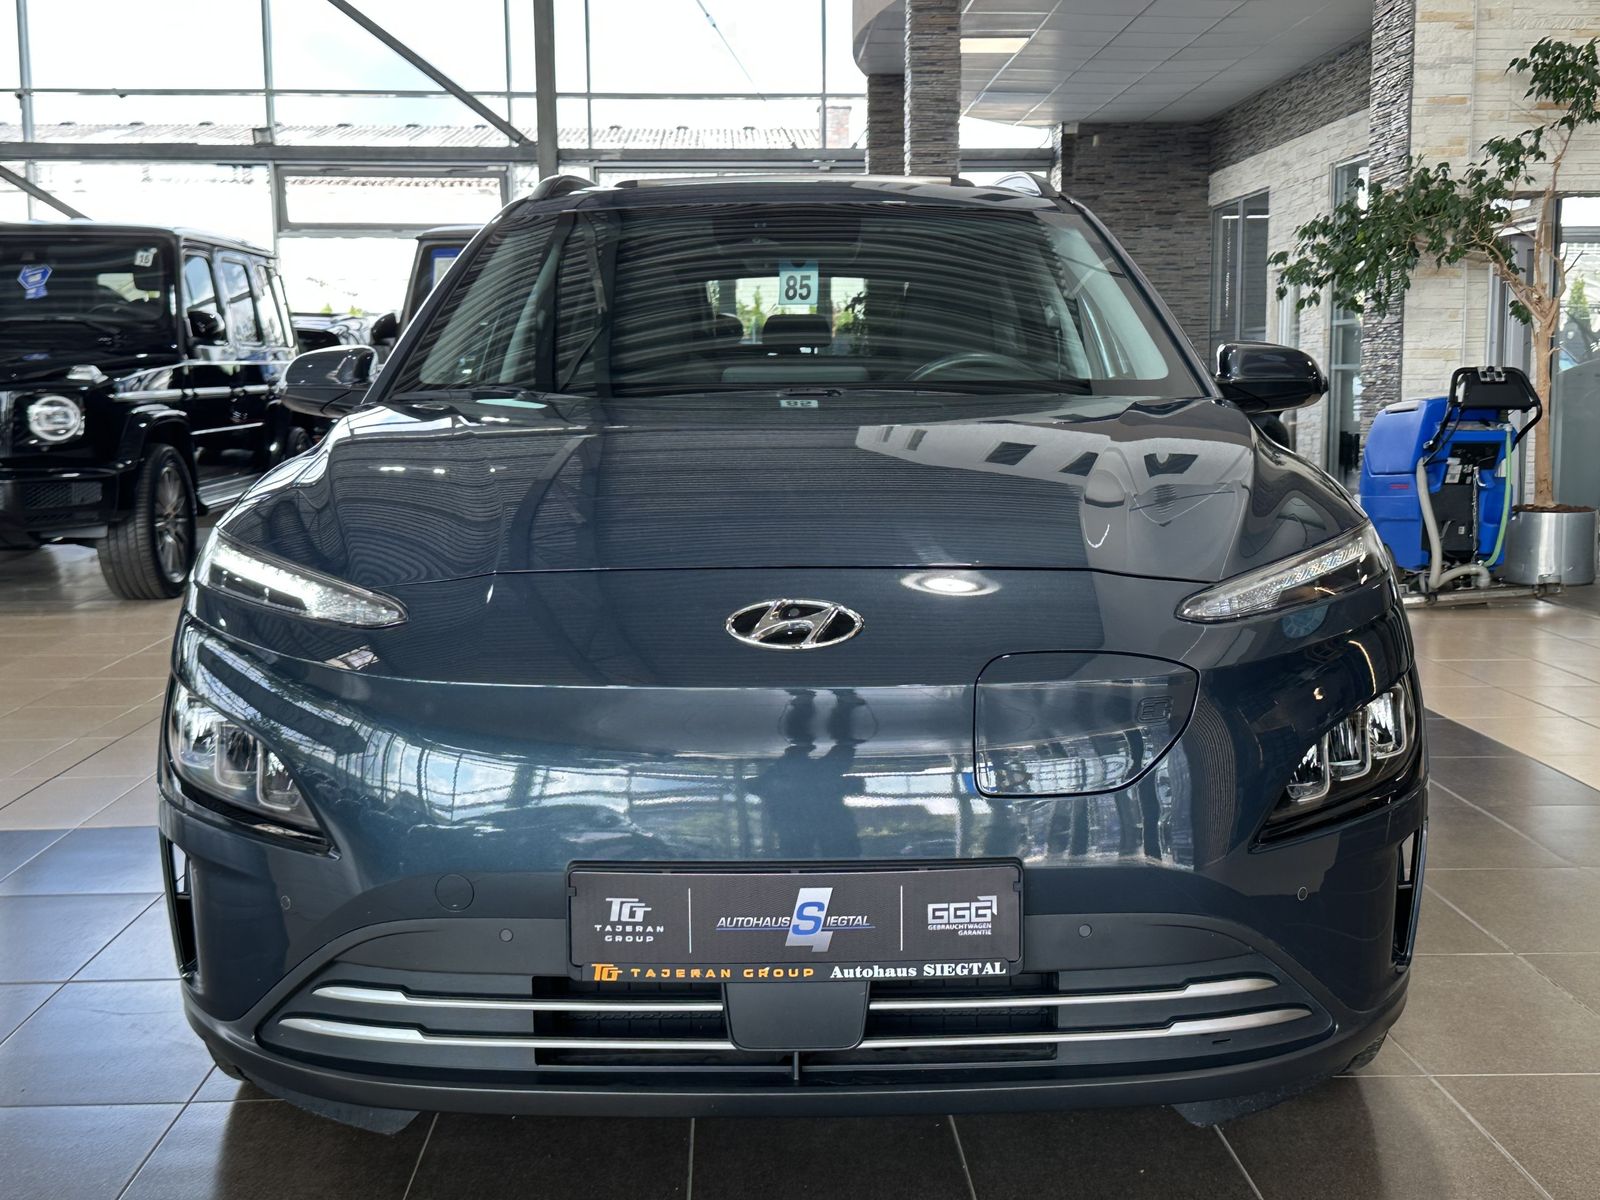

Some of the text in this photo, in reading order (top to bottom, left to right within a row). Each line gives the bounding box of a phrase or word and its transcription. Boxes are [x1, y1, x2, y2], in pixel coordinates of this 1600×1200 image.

[784, 275, 812, 301] 85
[927, 901, 992, 924] GGG
[594, 924, 664, 933] TAJERAN
[716, 916, 792, 928] AUTOHAUS
[927, 922, 992, 931] GEBRAUCHTWAGEN
[630, 968, 731, 978] TAJERAN
[743, 967, 814, 978] GROUP
[830, 965, 917, 979] Autohaus
[923, 961, 1007, 976] SIEGTAL
